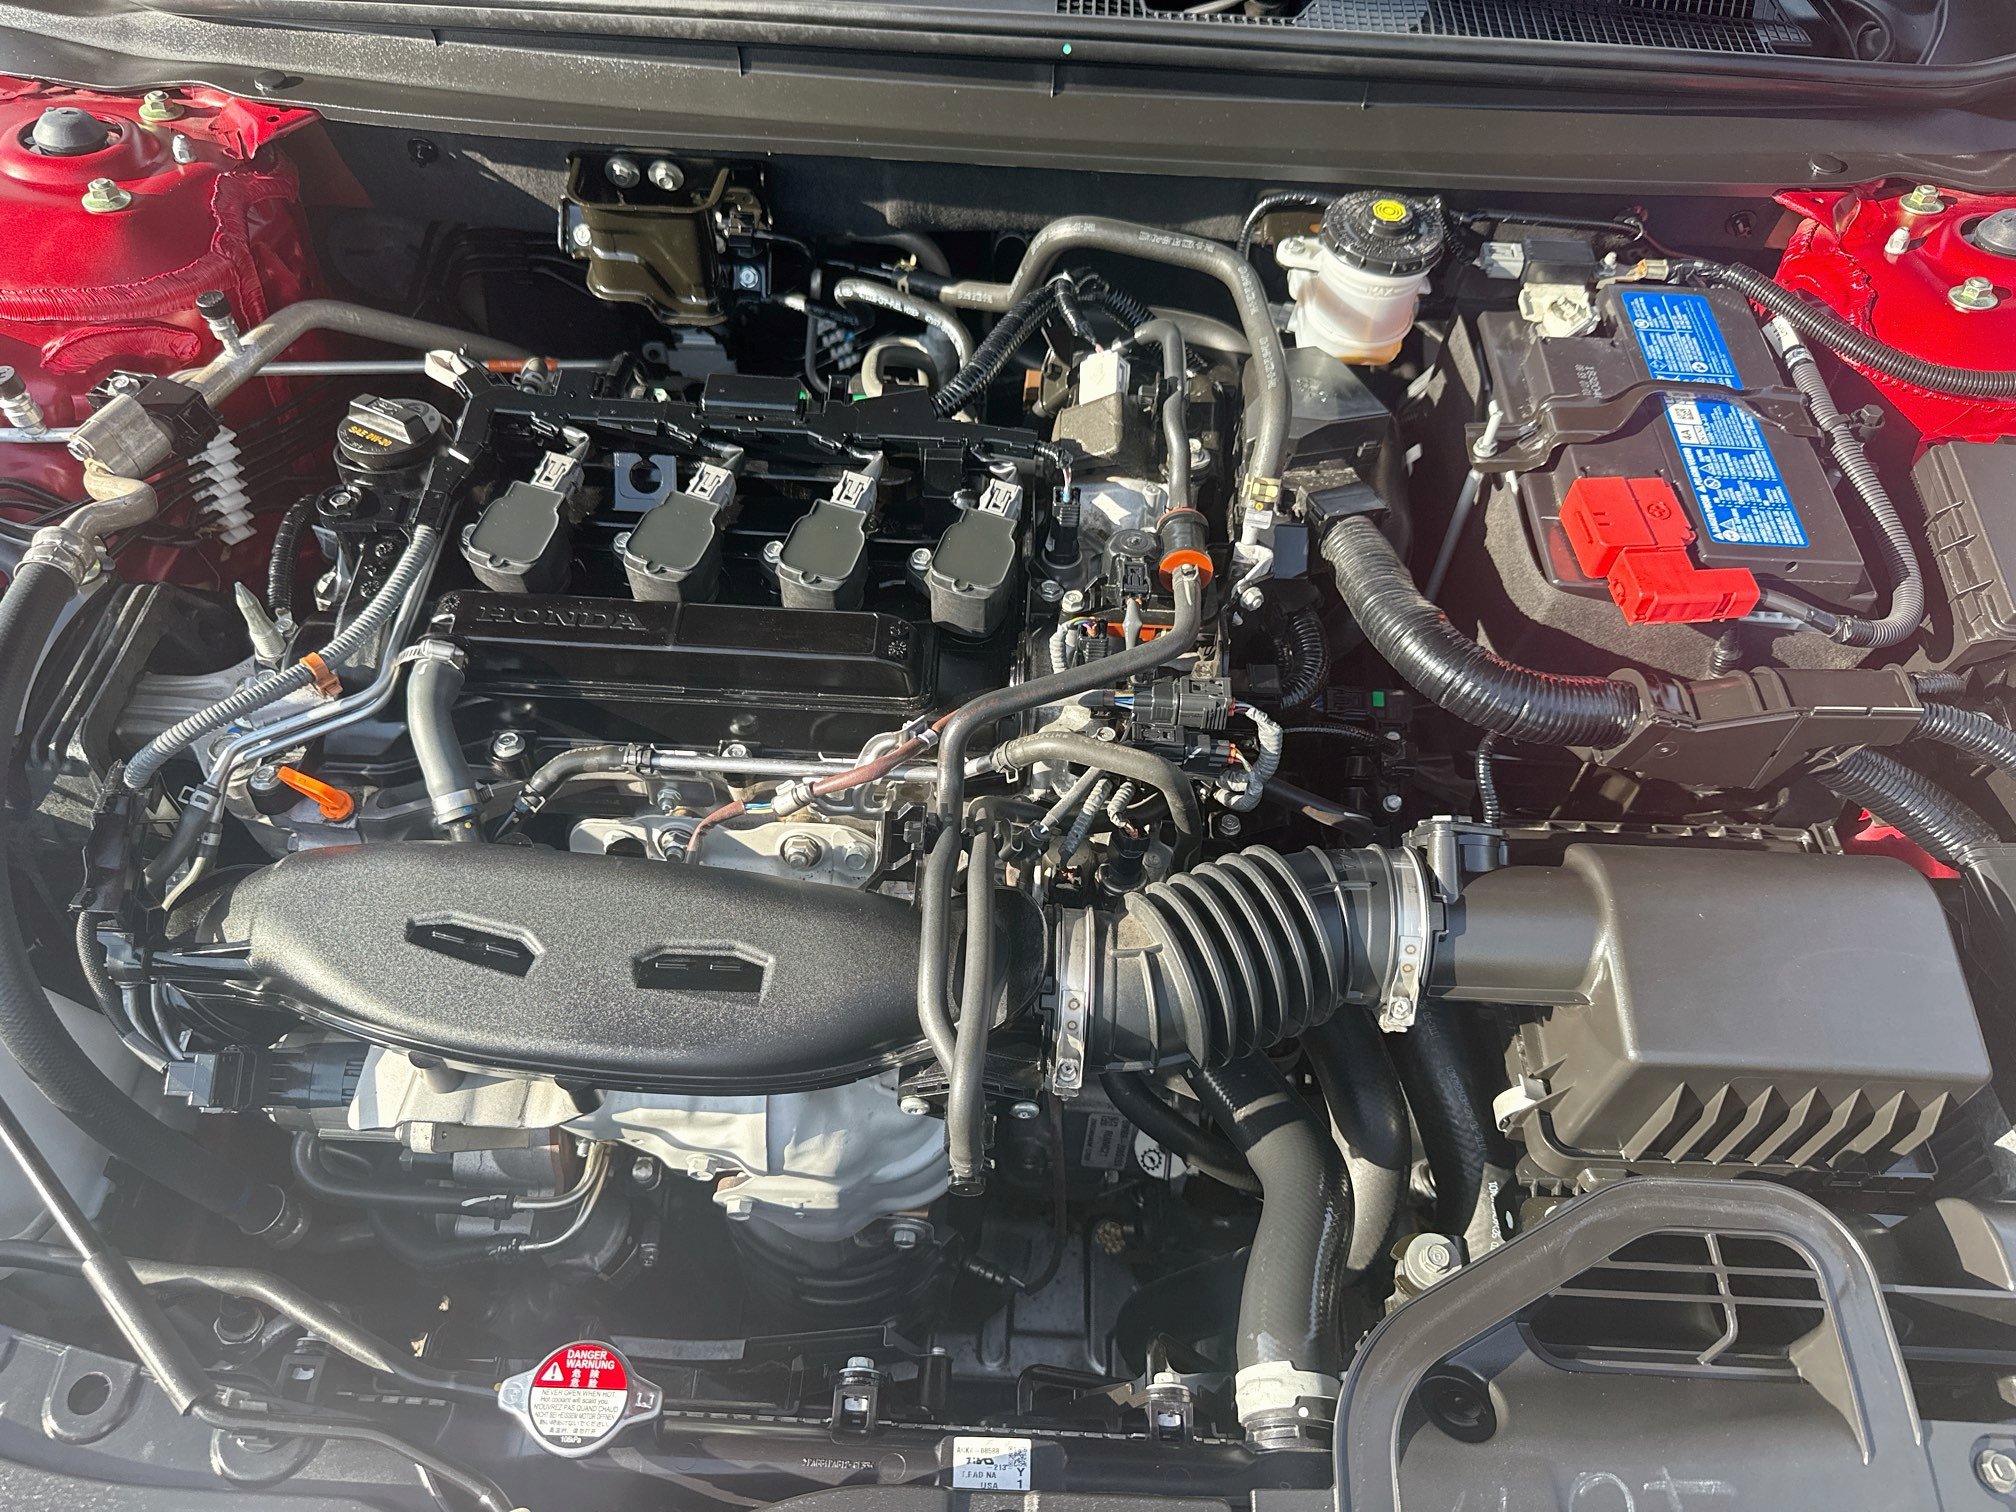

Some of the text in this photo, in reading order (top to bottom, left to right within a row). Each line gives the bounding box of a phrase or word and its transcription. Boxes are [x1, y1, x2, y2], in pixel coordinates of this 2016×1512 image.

[347, 425, 367, 438] SAE
[365, 432, 392, 447] 0W-20
[475, 605, 648, 631] HONDA
[567, 1350, 607, 1360] DANGER
[566, 1359, 615, 1370] WARNUNG
[564, 1389, 580, 1397] OPEN
[598, 1405, 619, 1413] CHAUD
[985, 1471, 997, 1479] NA
[1016, 1468, 1025, 1476] Y
[980, 1482, 999, 1490] USA
